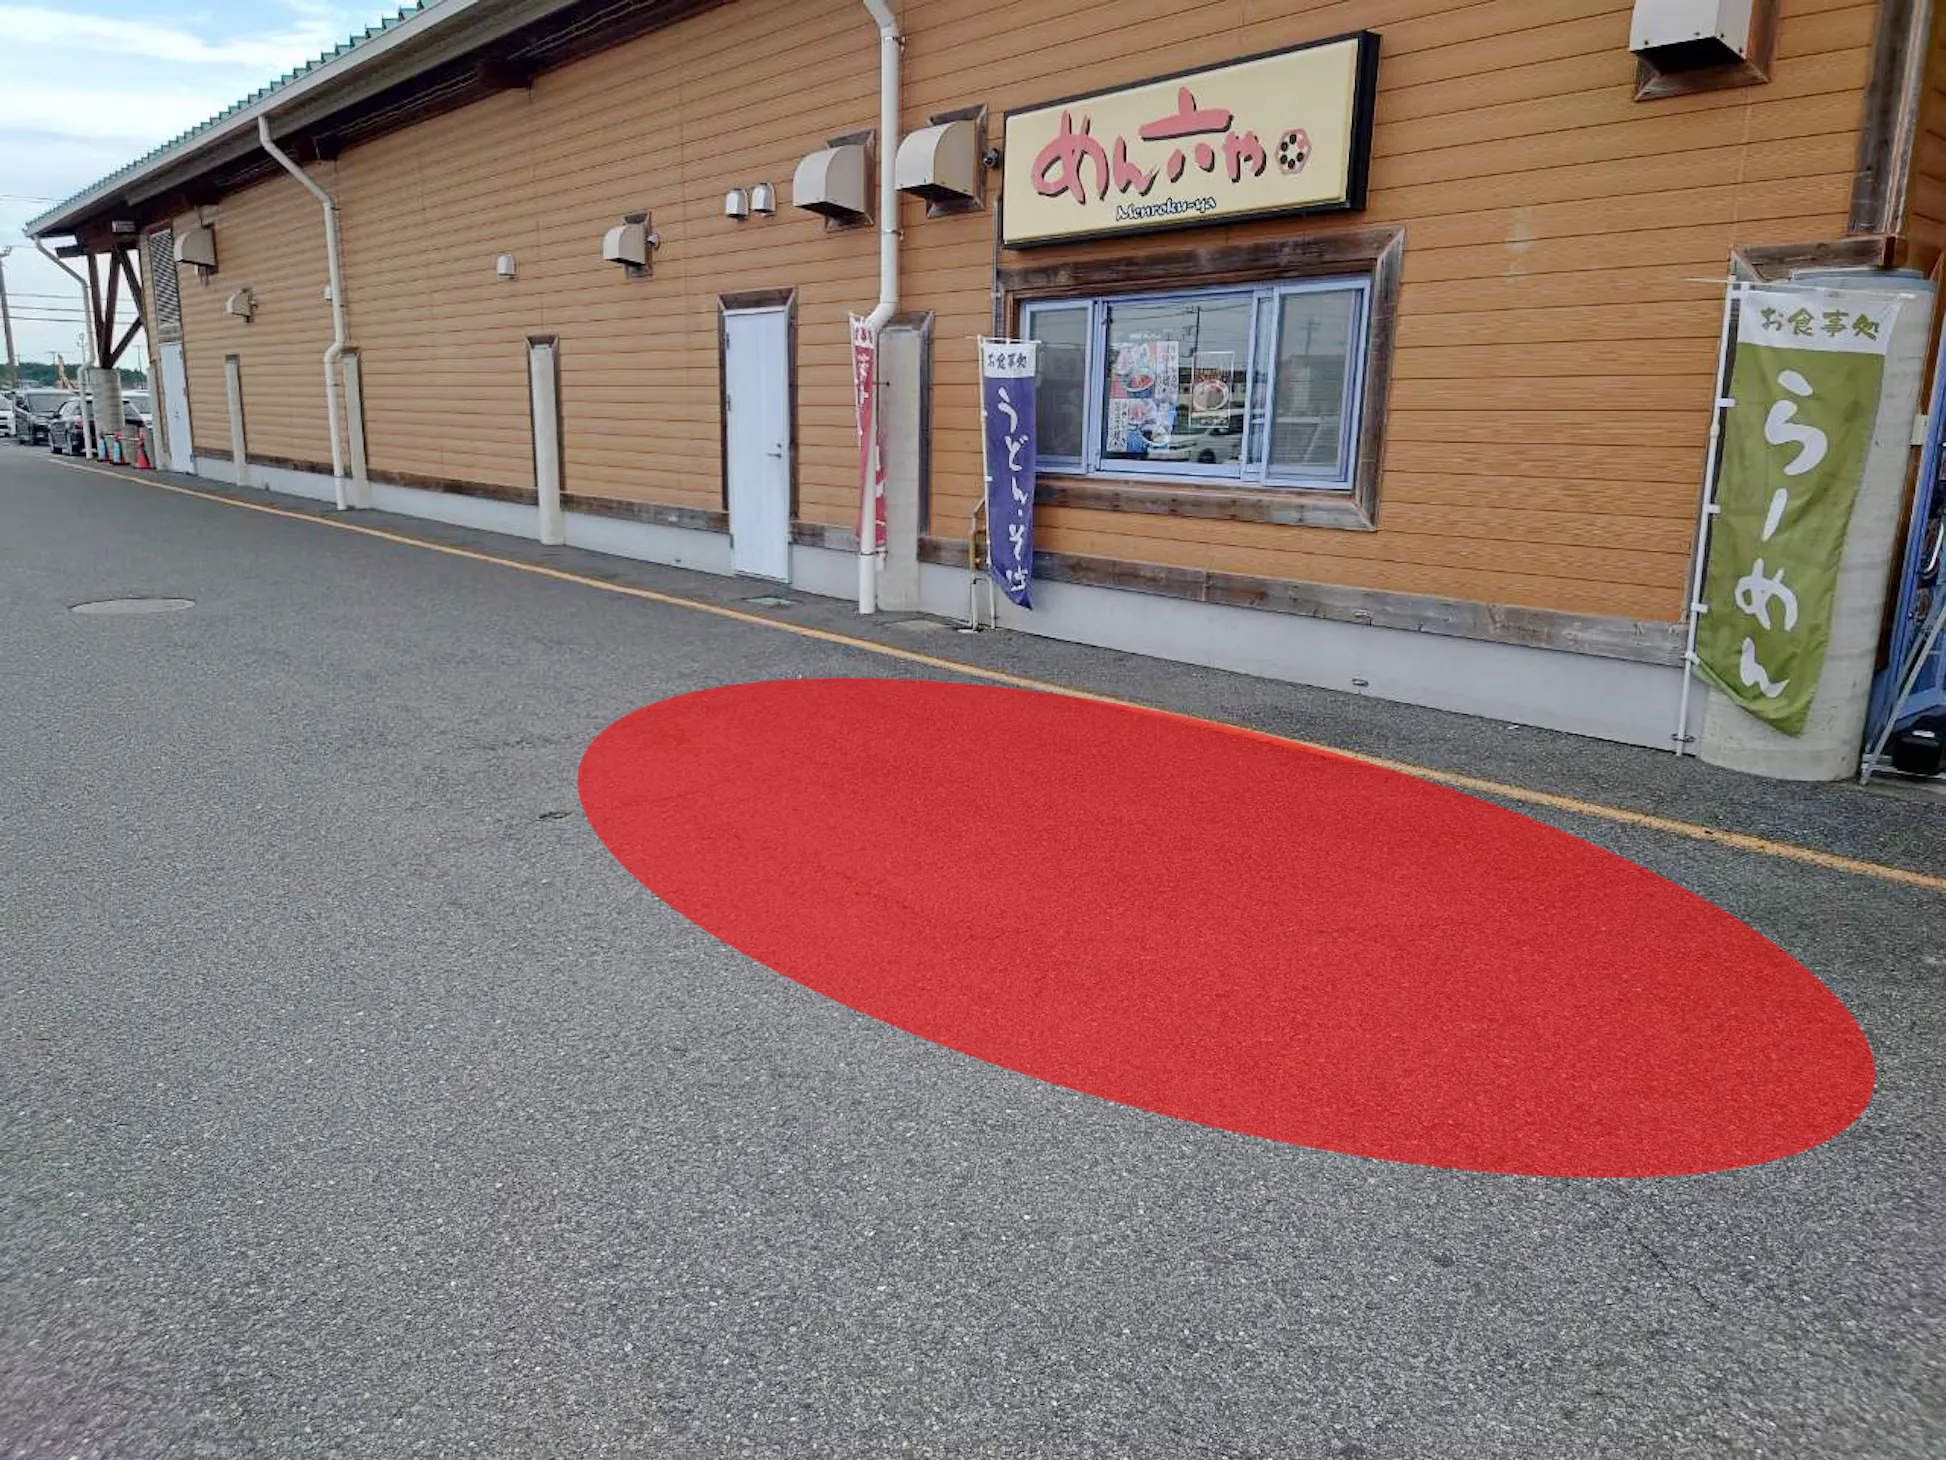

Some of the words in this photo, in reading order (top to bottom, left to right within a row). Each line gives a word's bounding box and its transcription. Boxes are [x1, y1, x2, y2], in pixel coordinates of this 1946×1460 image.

[1031, 86, 1267, 205] めん六や
[1116, 197, 1216, 220] Menroku-ya
[1760, 306, 1881, 342] お食事処
[1735, 369, 1828, 698] らーめん
